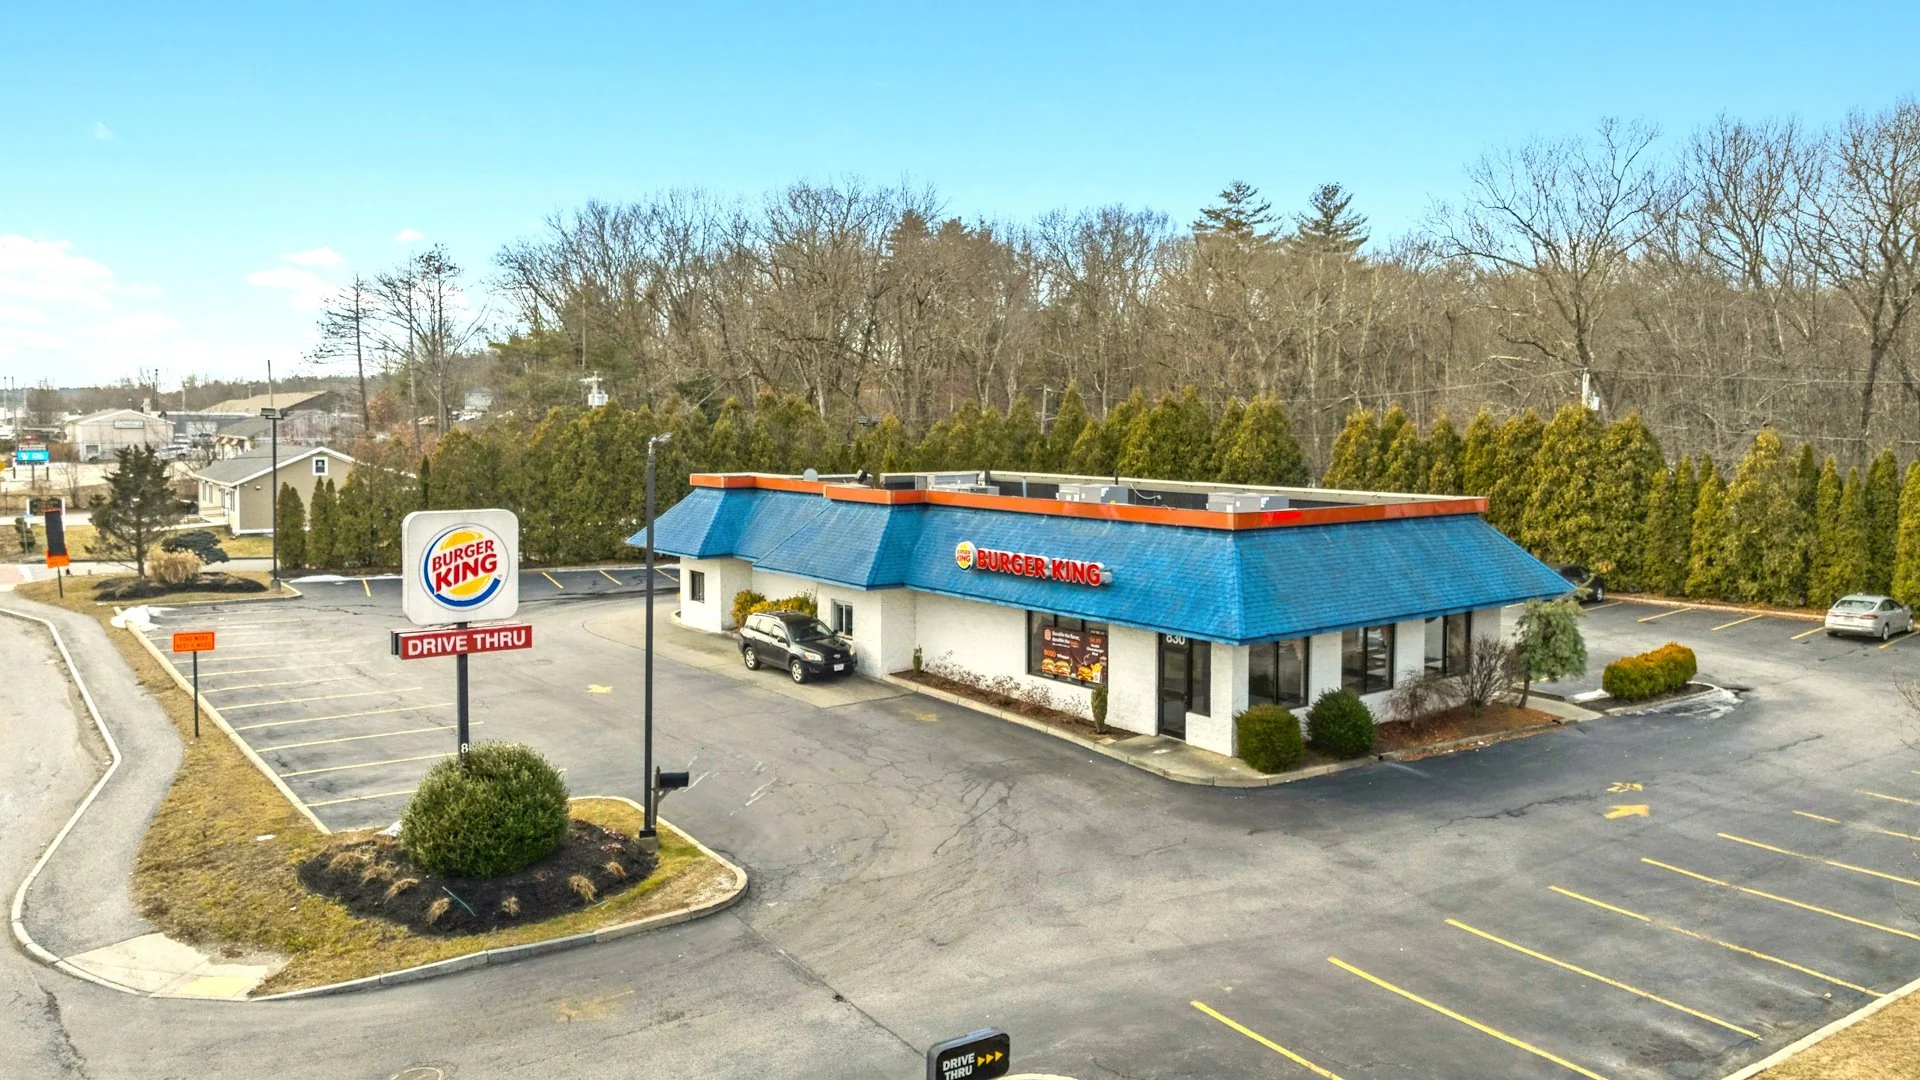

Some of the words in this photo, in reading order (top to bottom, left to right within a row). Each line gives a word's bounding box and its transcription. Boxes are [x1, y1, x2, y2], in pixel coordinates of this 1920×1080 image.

[432, 539, 494, 573] BURGER
[976, 549, 1047, 579] BURGER
[1051, 559, 1102, 587] KING
[435, 553, 497, 593] KING
[408, 635, 468, 656] DRIVE
[473, 629, 526, 649] THRU
[1166, 633, 1186, 645] 830
[943, 1052, 975, 1072] DRIVE
[944, 1065, 973, 1080] THRU
